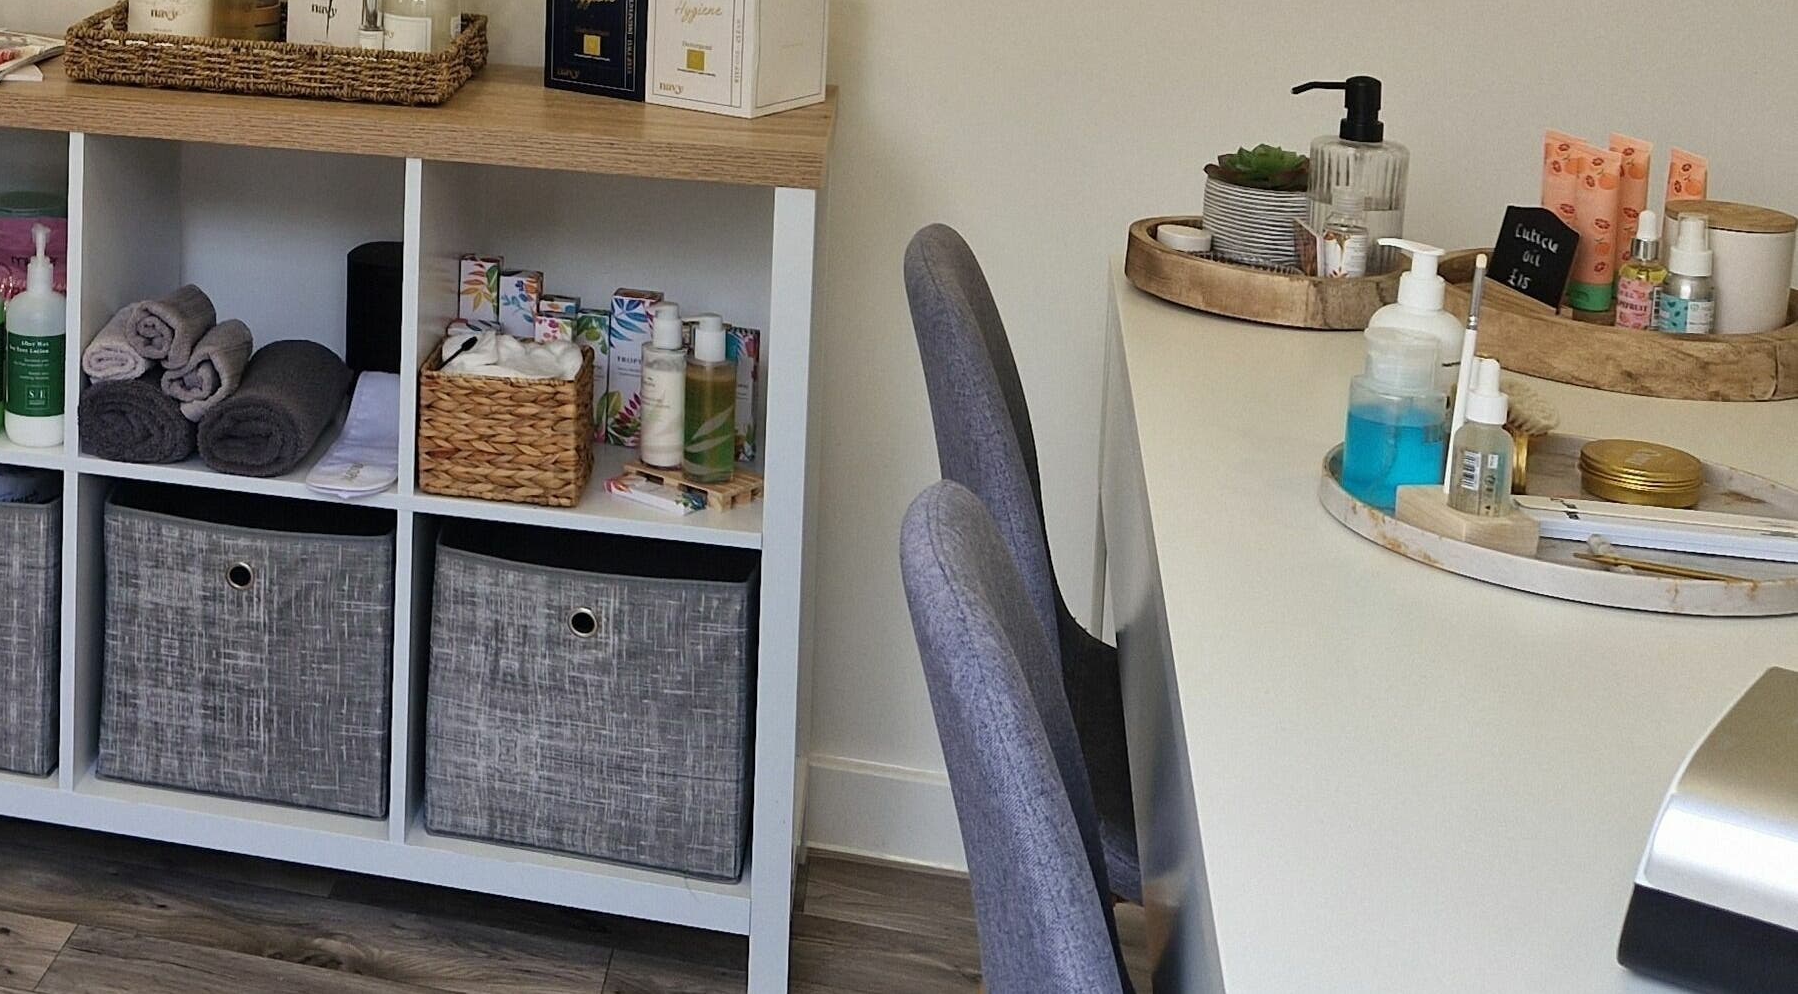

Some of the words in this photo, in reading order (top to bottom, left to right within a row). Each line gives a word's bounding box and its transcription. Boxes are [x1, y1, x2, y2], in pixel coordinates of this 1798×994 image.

[150, 9, 179, 21] navy
[311, 3, 338, 19] navy
[674, 0, 723, 24] Hygiene
[659, 82, 684, 95] navy
[1508, 268, 1531, 290] £15
